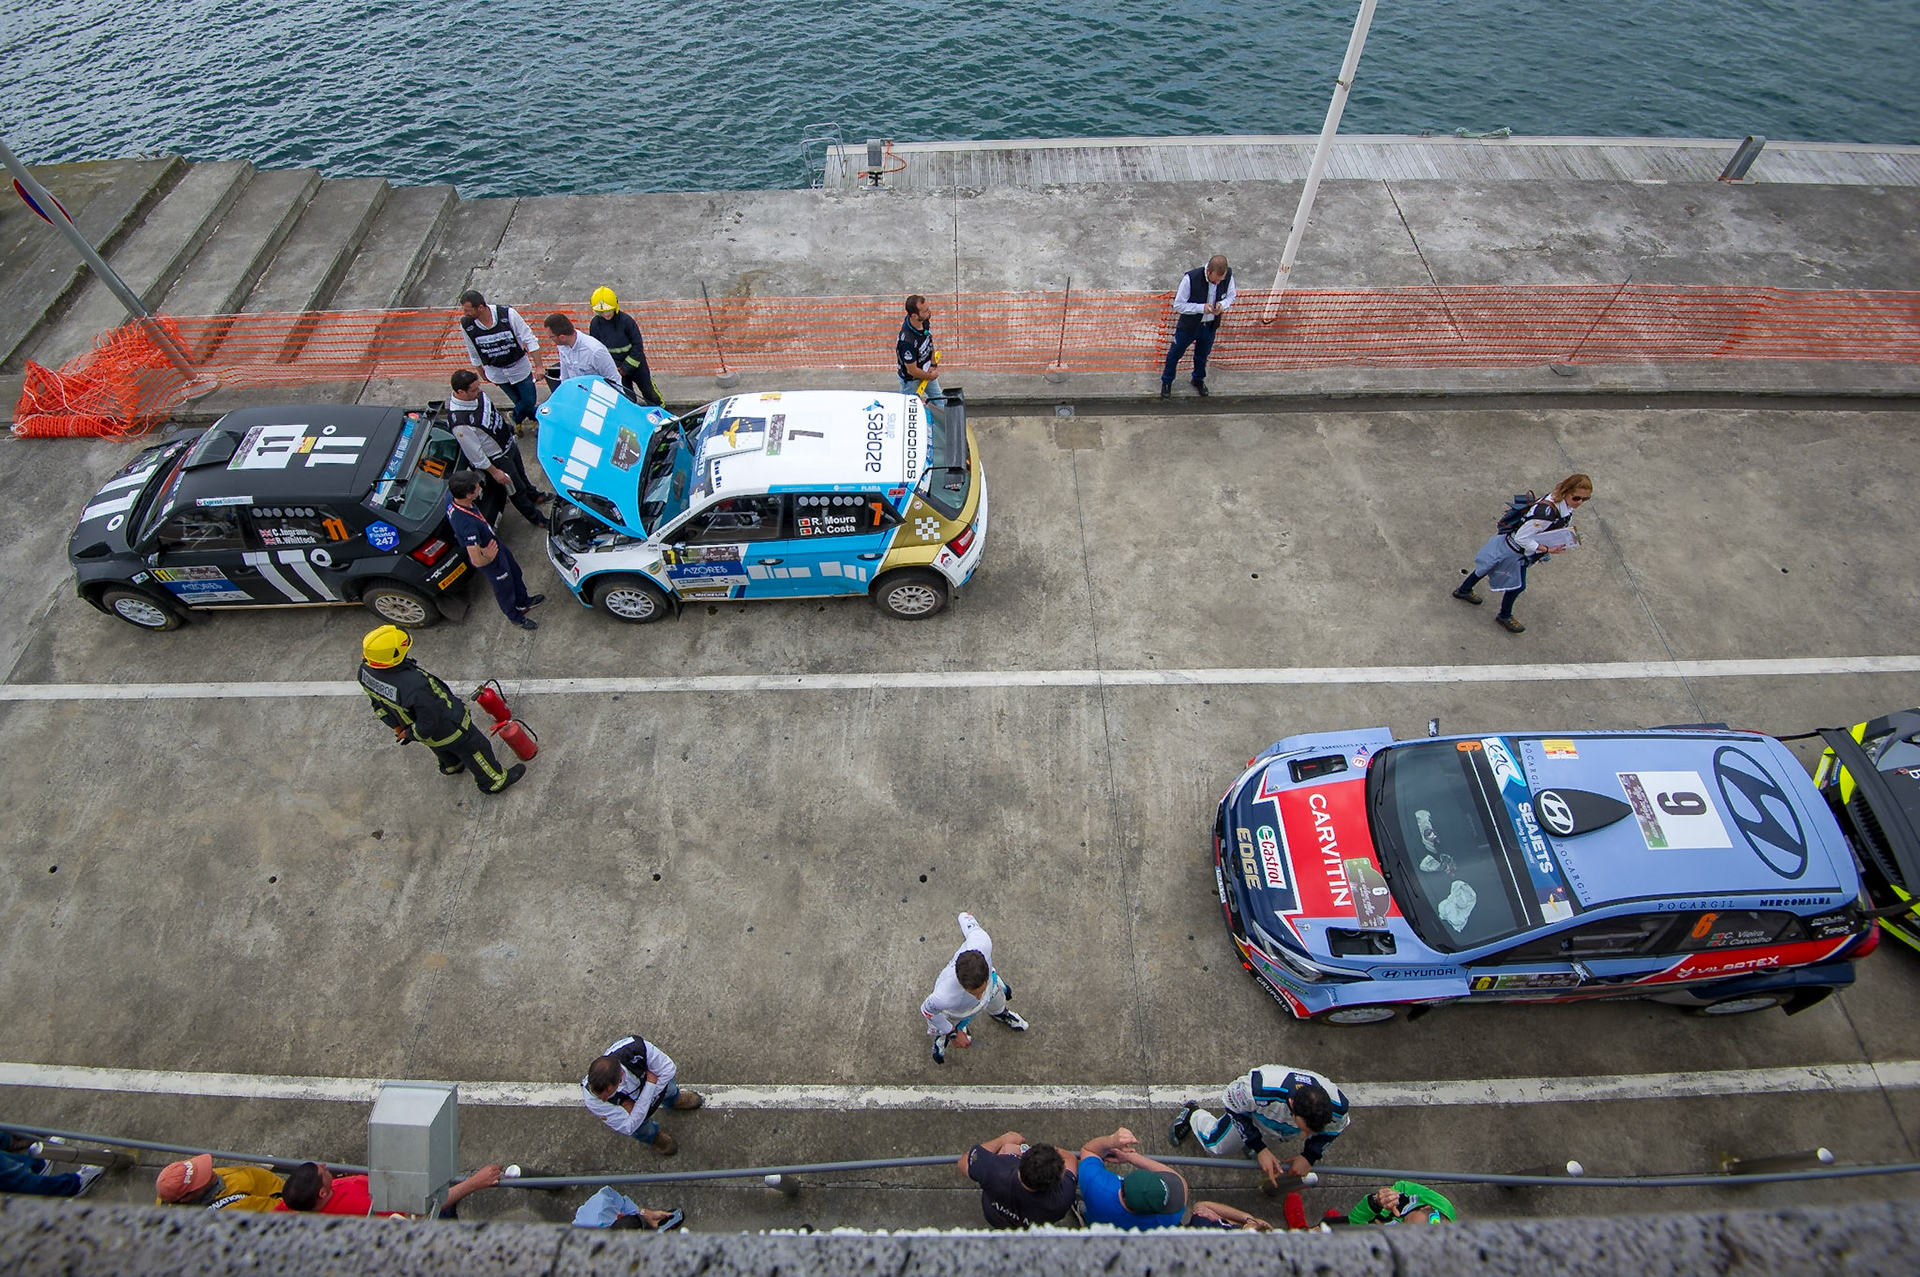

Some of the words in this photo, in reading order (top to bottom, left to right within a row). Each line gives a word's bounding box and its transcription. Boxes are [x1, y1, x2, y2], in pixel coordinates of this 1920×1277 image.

[907, 397, 918, 479] SOCICORREIA
[812, 517, 822, 526] R.
[825, 515, 856, 524] Moura
[871, 503, 883, 526] 7
[322, 518, 349, 541] 11
[372, 525, 388, 533] Car
[827, 525, 855, 533] Costa
[375, 536, 394, 546] 247
[1517, 802, 1554, 874] SEAJETS
[1236, 828, 1262, 890] EDGE
[1308, 793, 1352, 908] CARVITIN
[1262, 841, 1283, 884] Castrol
[1555, 843, 1592, 903] POCARGIL
[1657, 900, 1735, 911] POCARGIL
[1691, 912, 1717, 939] 6
[1404, 968, 1457, 977] HYUNDAI
[1475, 976, 1492, 990] 6
